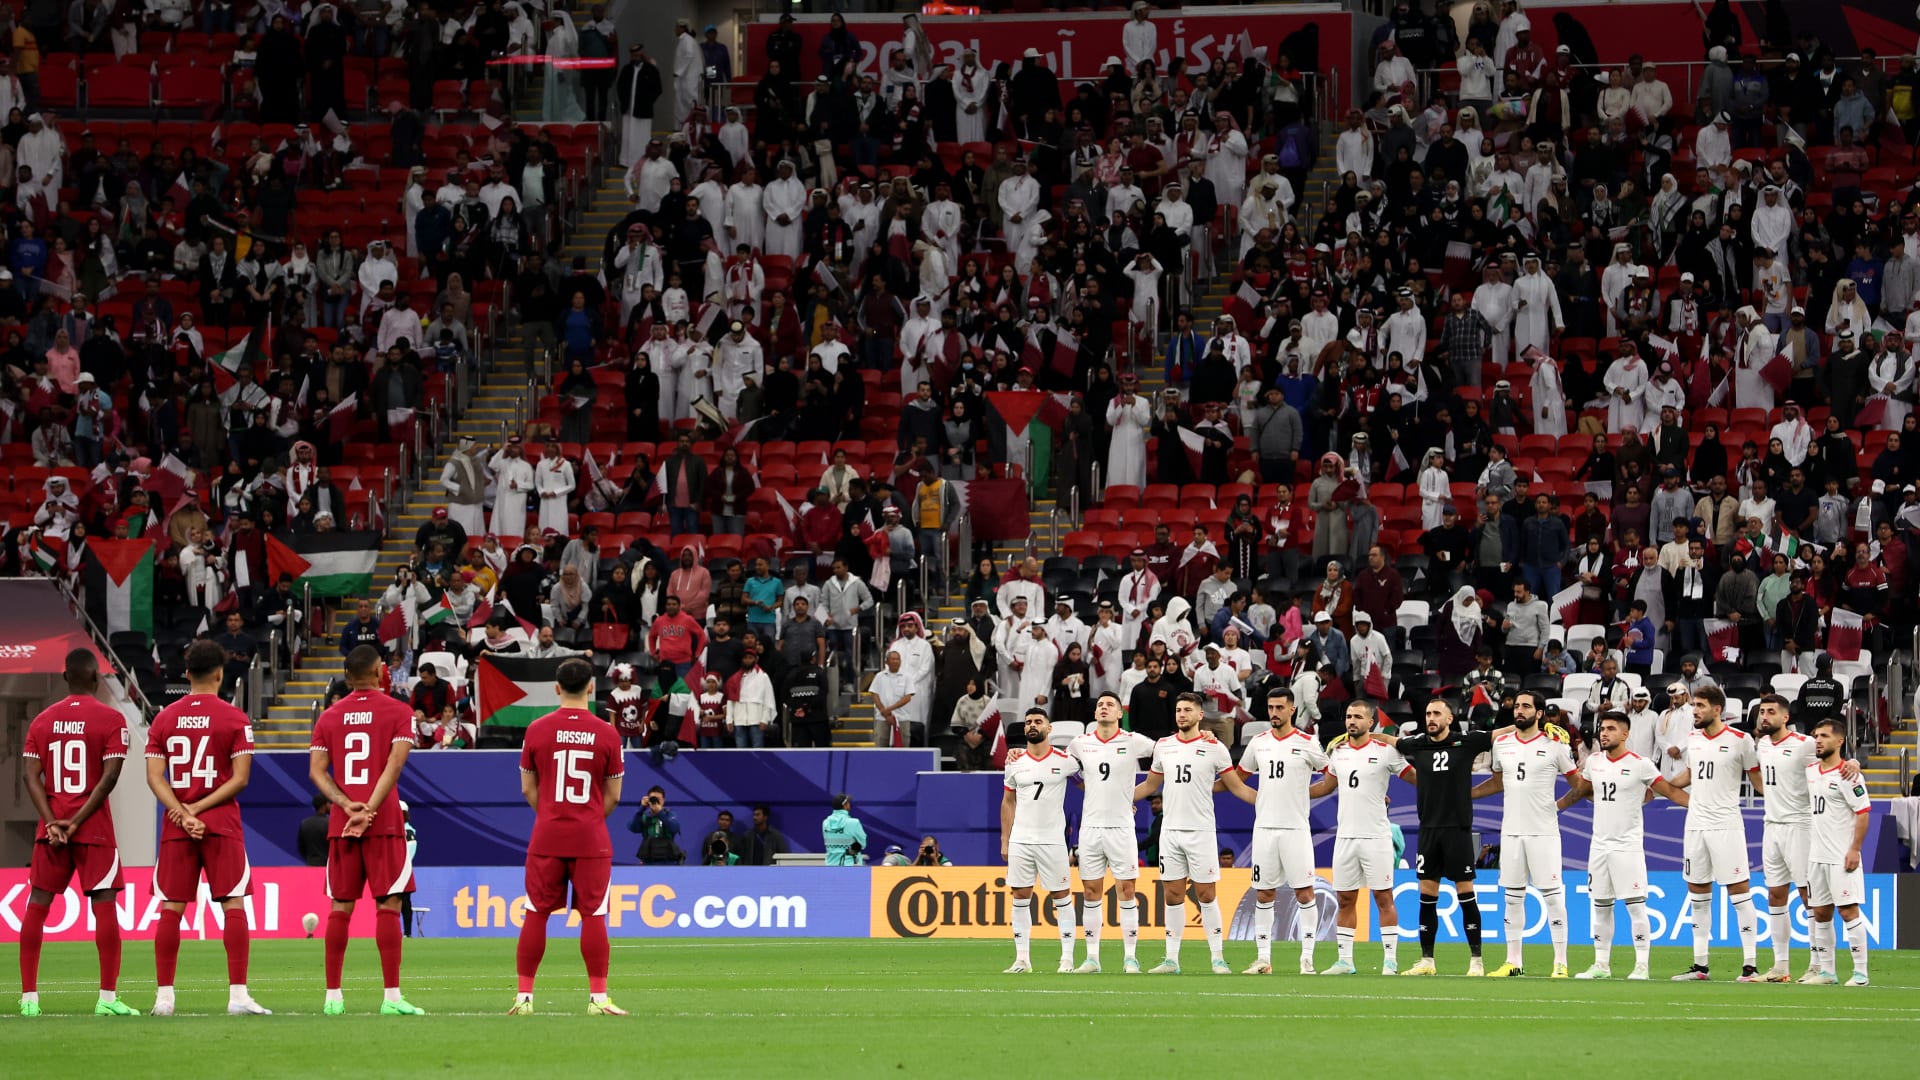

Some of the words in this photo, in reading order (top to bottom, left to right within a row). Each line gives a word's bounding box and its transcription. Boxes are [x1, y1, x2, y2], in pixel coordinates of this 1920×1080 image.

[661, 625, 685, 638] GAP
[53, 720, 86, 734] ALMOEZ
[176, 715, 210, 729] JASSEM
[343, 711, 373, 725] PEDRO
[556, 730, 596, 746] BASSAM
[48, 739, 87, 794] 19
[166, 735, 218, 789] 24
[344, 731, 370, 785] 2
[1432, 750, 1449, 772] 22
[553, 749, 595, 804] 15
[1098, 762, 1110, 781] 9
[1174, 764, 1192, 784] 15
[1268, 759, 1285, 780] 18
[1349, 770, 1360, 789] 6
[1516, 762, 1526, 781] 5
[1698, 760, 1714, 780] 20
[1765, 765, 1777, 786] 11
[1033, 781, 1044, 801] 7
[1601, 781, 1616, 802] 12
[1813, 795, 1825, 815] 10
[453, 884, 807, 929] the-FC.com
